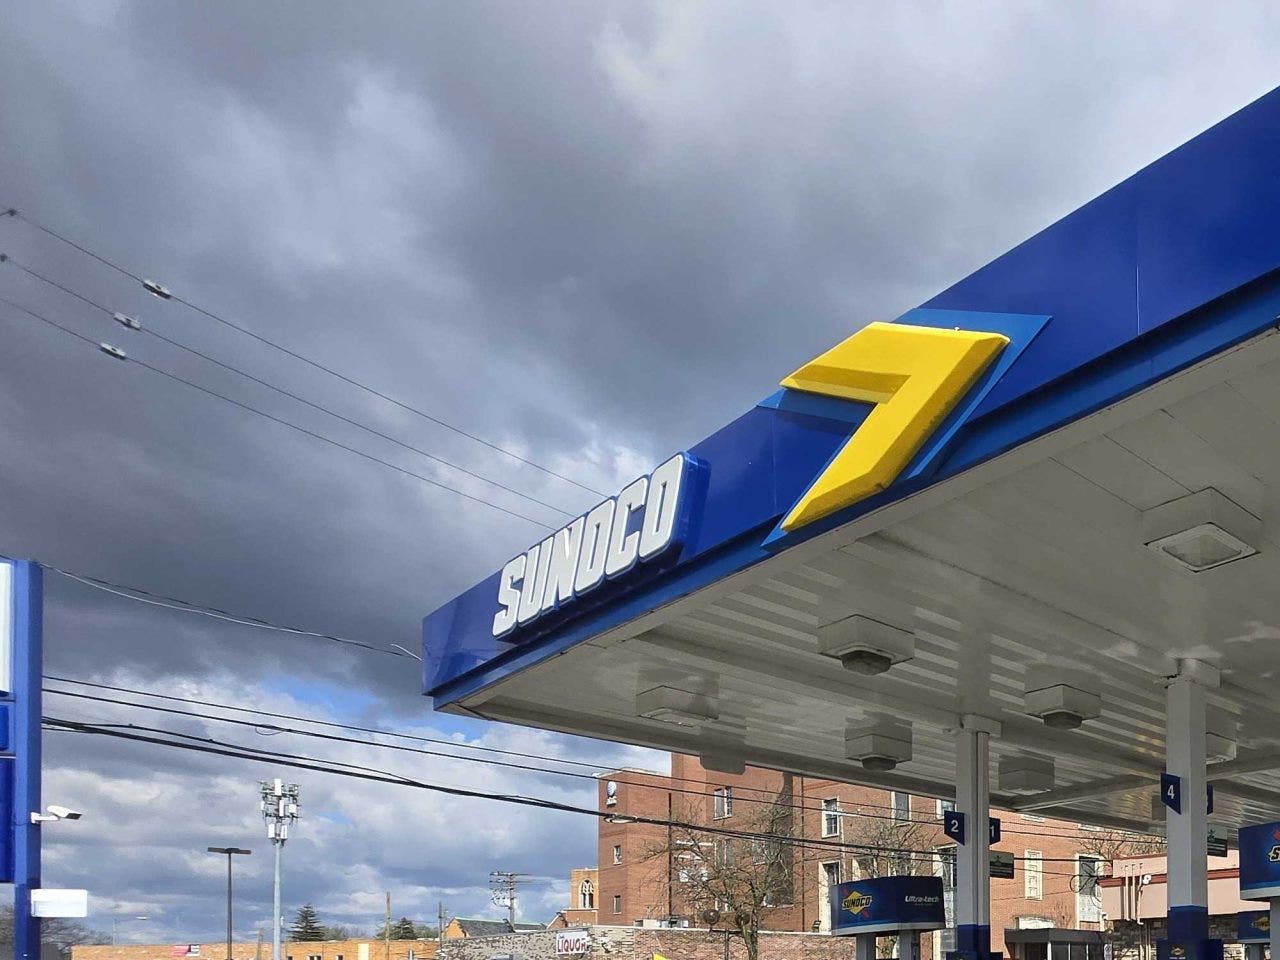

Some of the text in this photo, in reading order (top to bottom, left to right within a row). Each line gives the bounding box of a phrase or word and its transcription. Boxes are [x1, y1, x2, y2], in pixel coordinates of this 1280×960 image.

[492, 453, 684, 637] SUNOCO
[1167, 784, 1175, 800] 4
[951, 819, 959, 833] 2
[842, 896, 871, 909] SUNOCO
